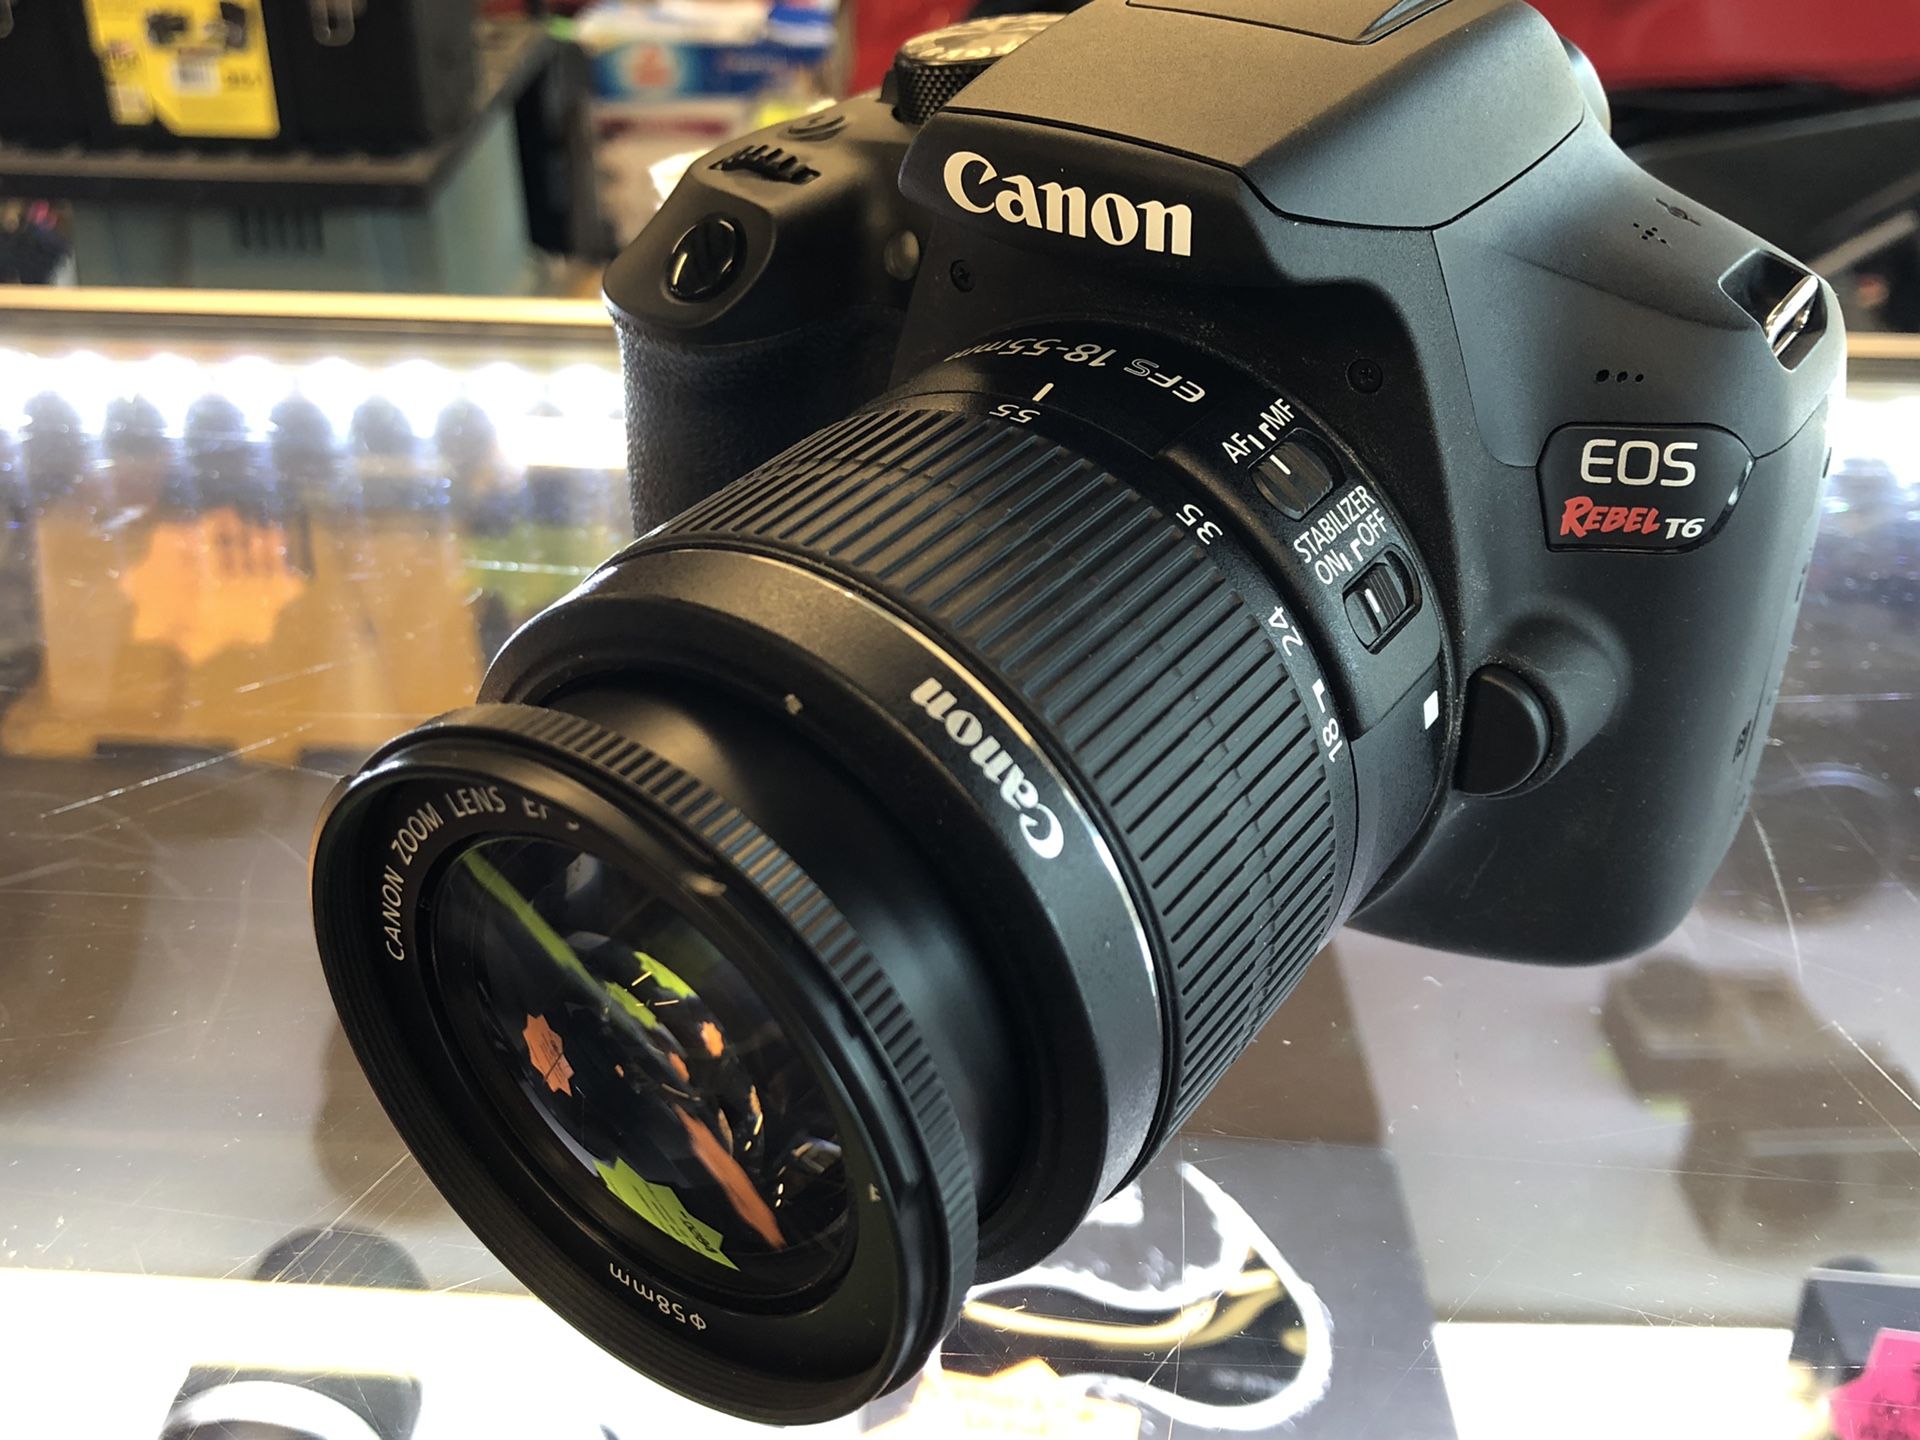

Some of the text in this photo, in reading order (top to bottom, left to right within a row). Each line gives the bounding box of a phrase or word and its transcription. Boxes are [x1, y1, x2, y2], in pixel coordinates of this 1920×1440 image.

[942, 151, 1192, 257] Canon
[989, 404, 1041, 423] 55
[1221, 398, 1295, 464] AF MF
[1580, 438, 1698, 487] EOS
[1176, 503, 1223, 545] 35
[1293, 485, 1376, 564] STABILIZER
[1559, 495, 1706, 540] REBEL T6
[1314, 508, 1388, 586] ON OFF
[1268, 606, 1304, 656] 24
[910, 677, 1065, 860] Canon
[1322, 717, 1343, 763] 18
[445, 786, 507, 818] LENS
[391, 802, 444, 866] ZOOM
[382, 865, 406, 961] CANON
